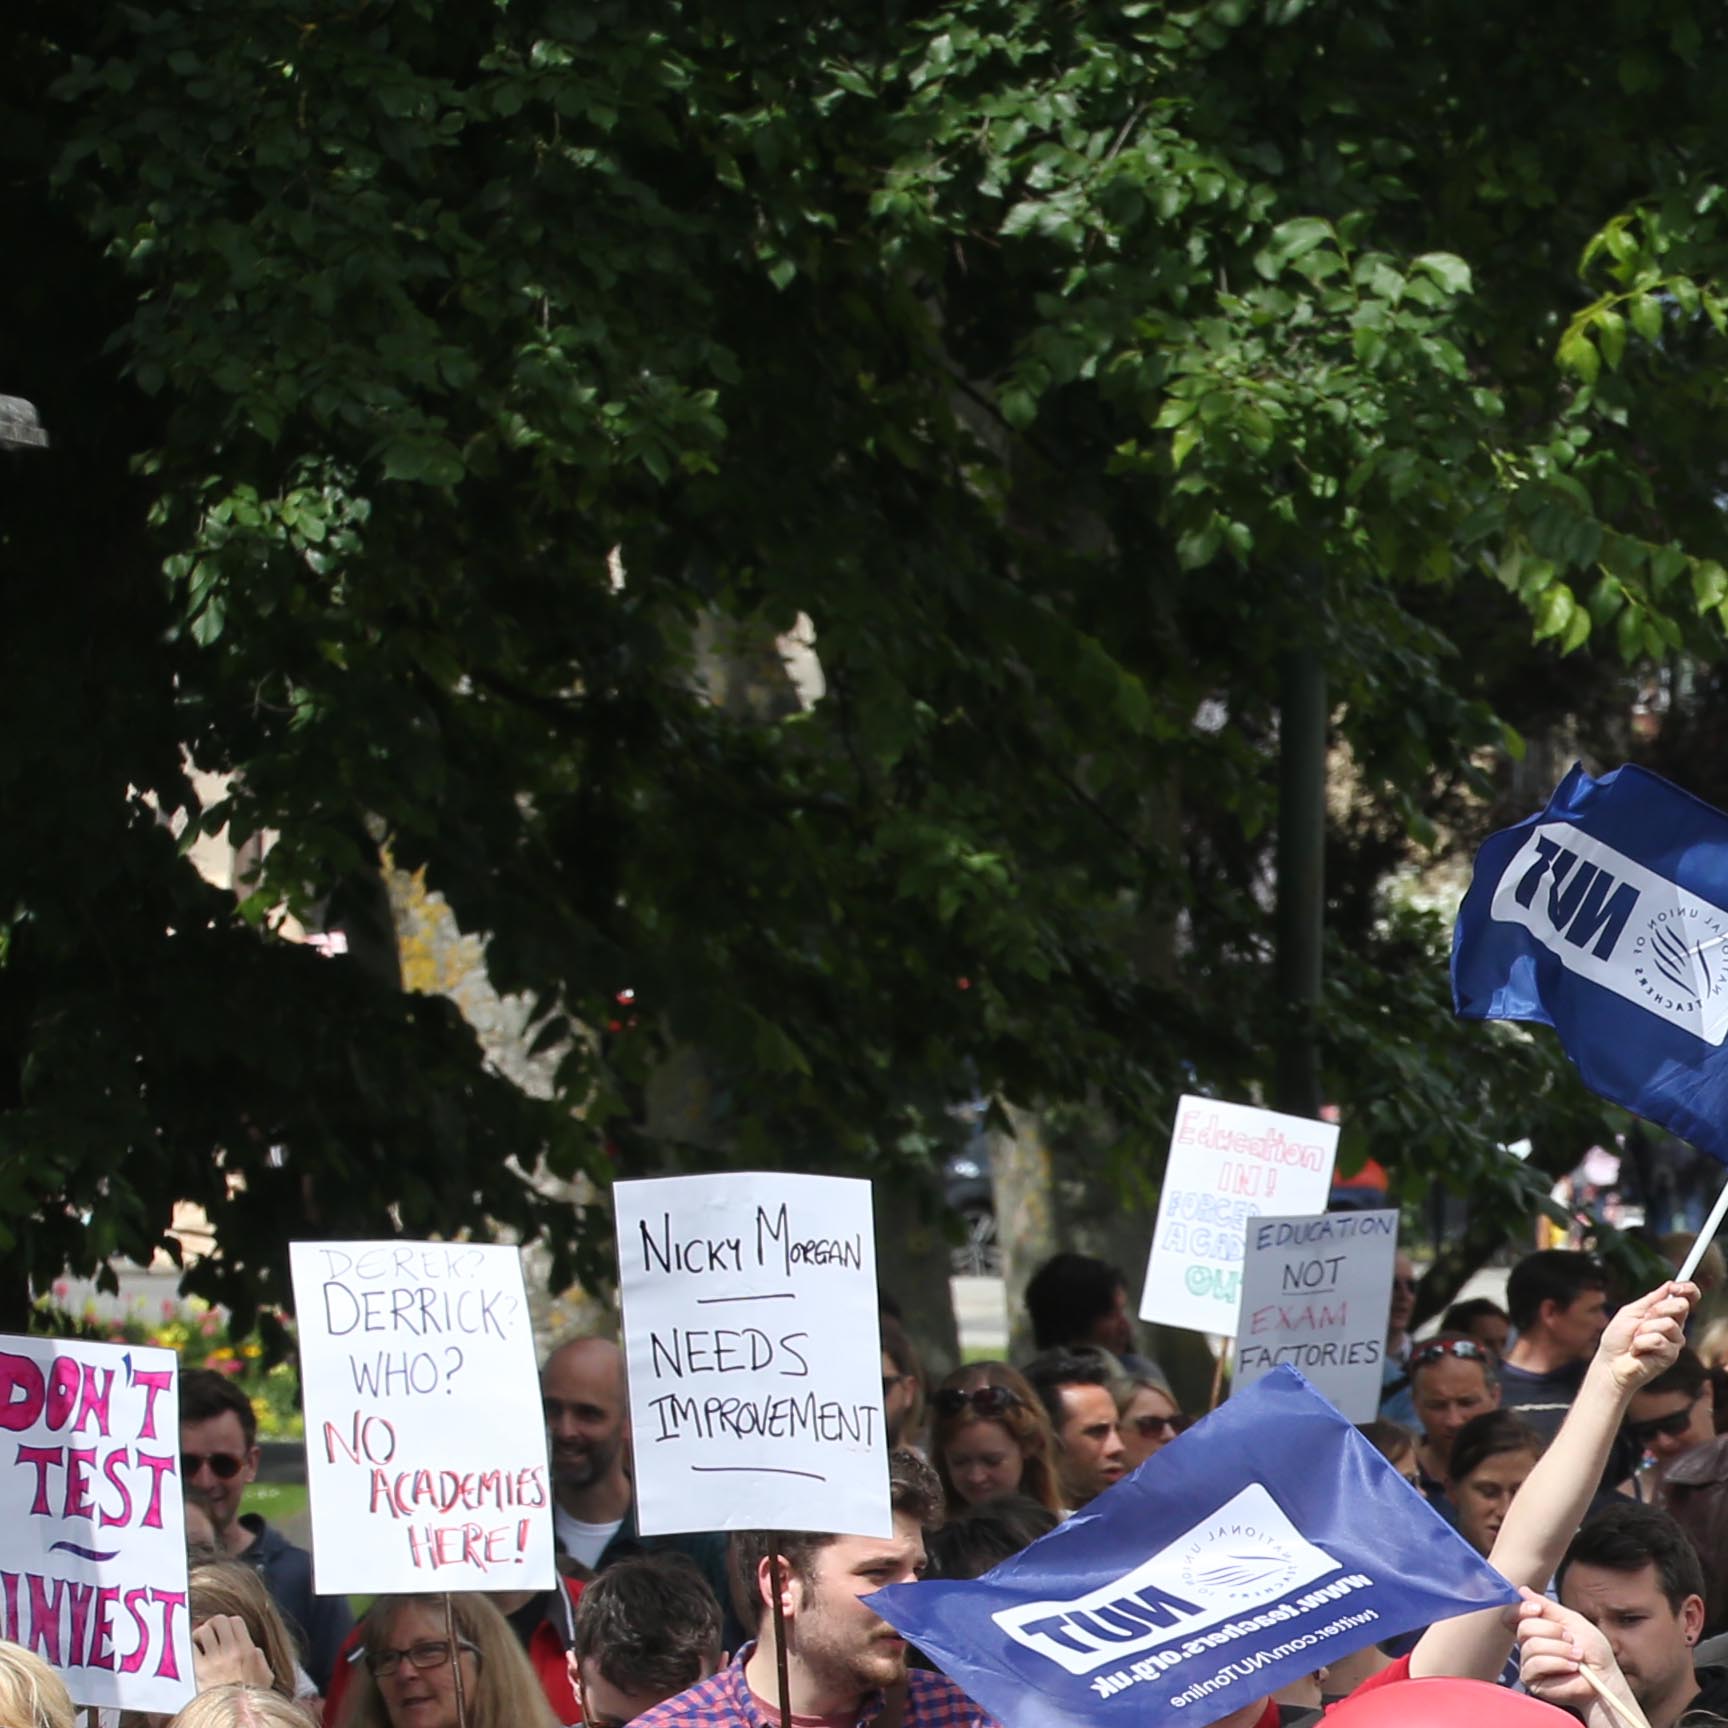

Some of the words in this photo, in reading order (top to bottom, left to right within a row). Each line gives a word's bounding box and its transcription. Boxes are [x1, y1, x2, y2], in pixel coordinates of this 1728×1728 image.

[1256, 1217, 1394, 1250] EDUCATION
[1282, 1256, 1346, 1290] NOT
[1251, 1302, 1347, 1334] EXAM
[351, 1346, 464, 1397] WHO?
[651, 1328, 808, 1377] NEEDS
[1239, 1340, 1380, 1373] FACTORIES
[0, 1352, 173, 1440] DON'T
[649, 1393, 878, 1446] IMPROVEMENT
[323, 1409, 396, 1465] NO
[14, 1444, 176, 1529] TEST
[370, 1464, 547, 1518] ACADEMIES
[408, 1518, 532, 1572] HERE!
[1, 1570, 187, 1682] INVEST
